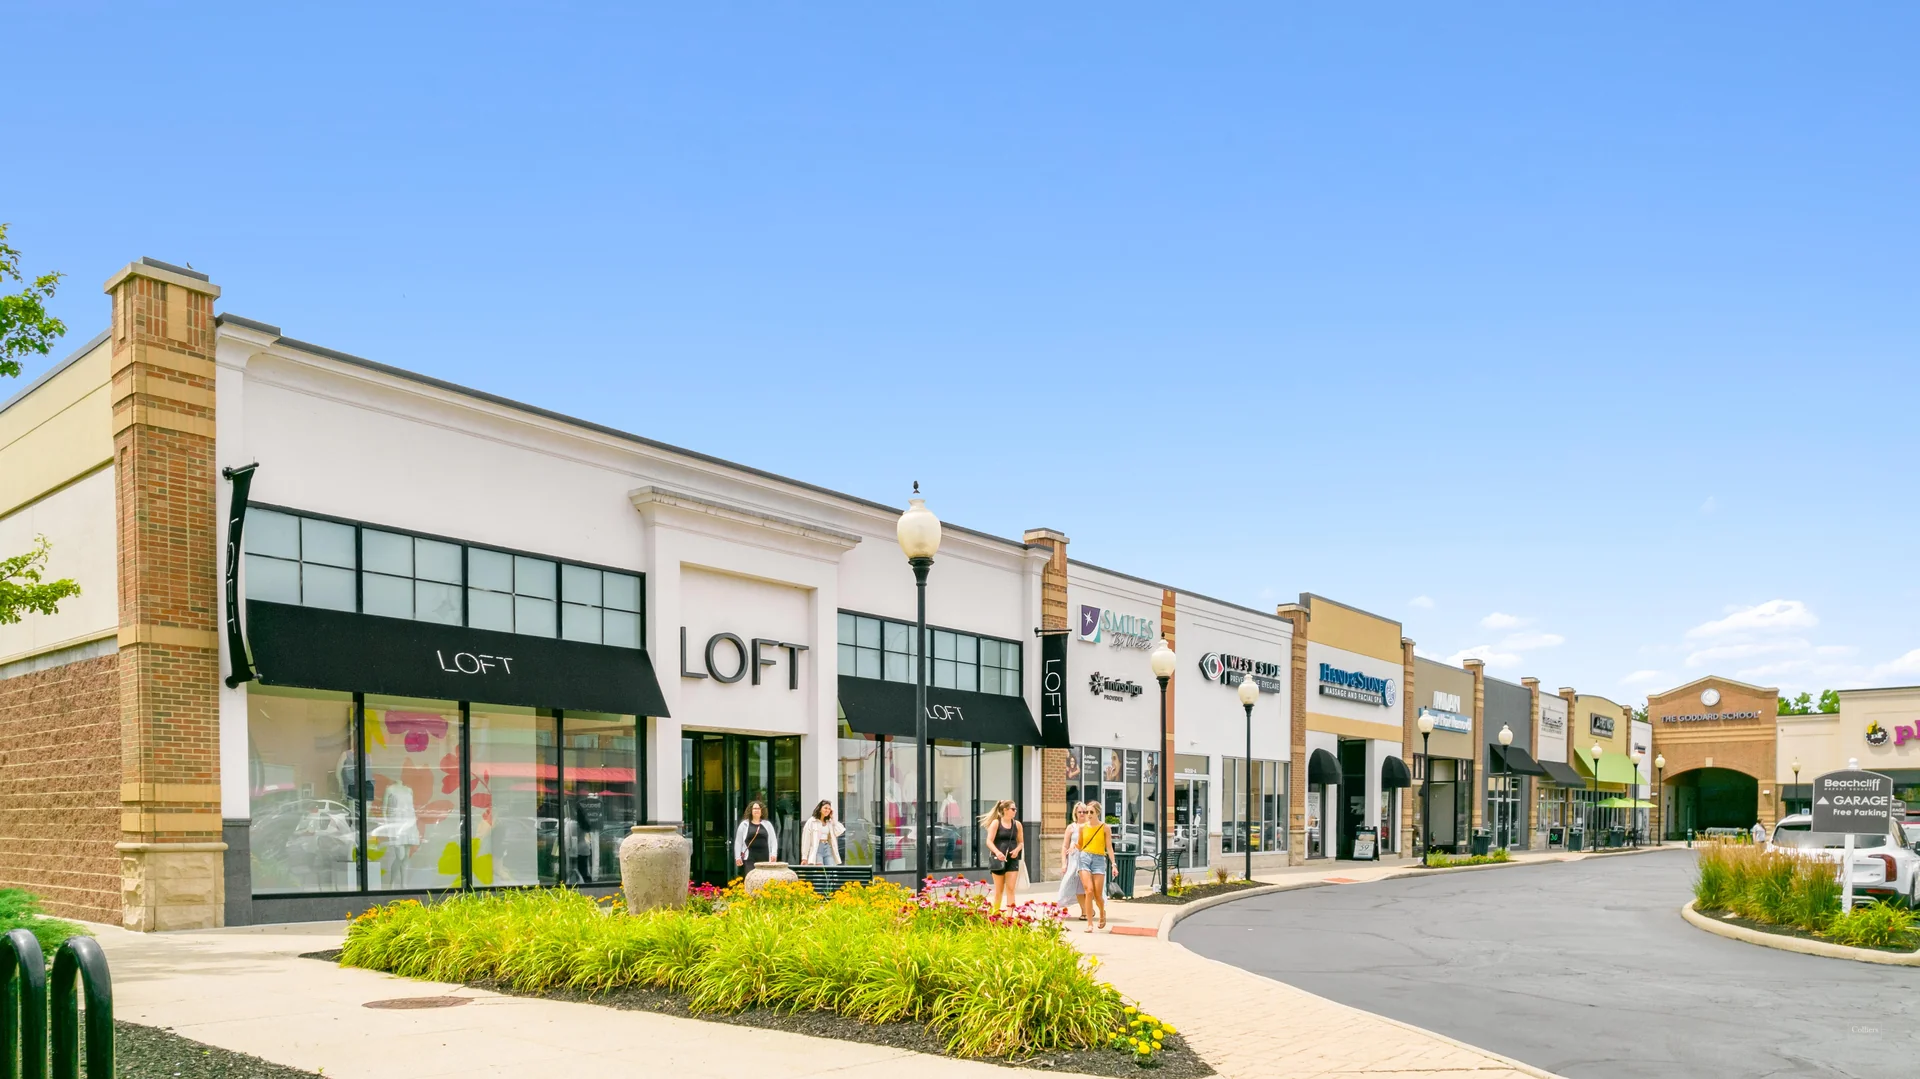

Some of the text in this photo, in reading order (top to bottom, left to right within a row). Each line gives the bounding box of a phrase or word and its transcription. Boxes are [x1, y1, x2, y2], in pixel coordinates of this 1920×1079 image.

[226, 517, 239, 635] LOFT
[1104, 609, 1153, 640] SMILES
[436, 650, 513, 675] LOFT
[680, 626, 810, 690] LOFT
[1228, 655, 1281, 677] WEST SIDE
[1045, 659, 1062, 723] LOFT
[1262, 681, 1280, 690] EYECARE
[1104, 694, 1123, 702] PROVIDER
[1325, 687, 1347, 697] MASSAGE
[1348, 691, 1357, 699] AND
[1358, 694, 1373, 702] FACIAL
[925, 704, 963, 720] LOFT
[1662, 711, 1758, 723] THE GODDARD SCHOOL
[1824, 779, 1881, 791] Beachcliff
[1833, 795, 1888, 806] GARAGE
[1833, 808, 1851, 816] Free
[1854, 808, 1888, 818] Parking
